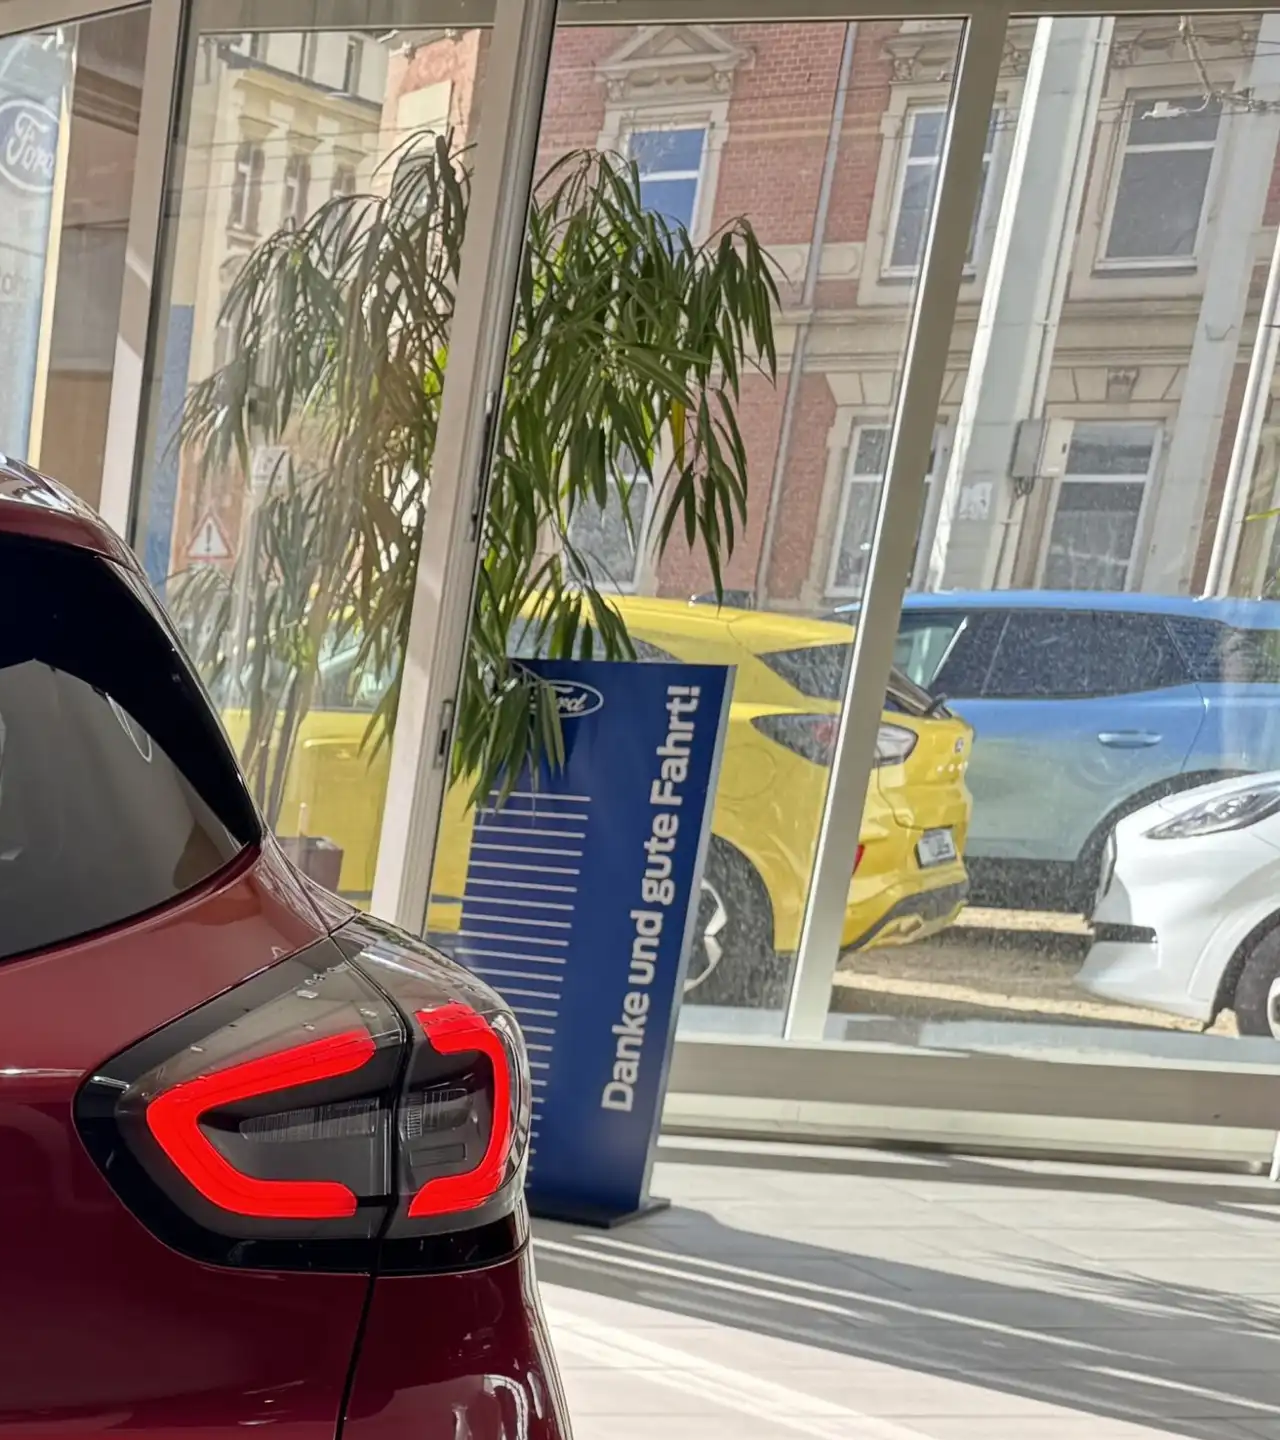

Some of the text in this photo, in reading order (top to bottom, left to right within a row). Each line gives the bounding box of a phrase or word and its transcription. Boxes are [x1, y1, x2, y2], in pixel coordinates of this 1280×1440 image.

[601, 685, 702, 1112] Danke und gute Fahrt!
